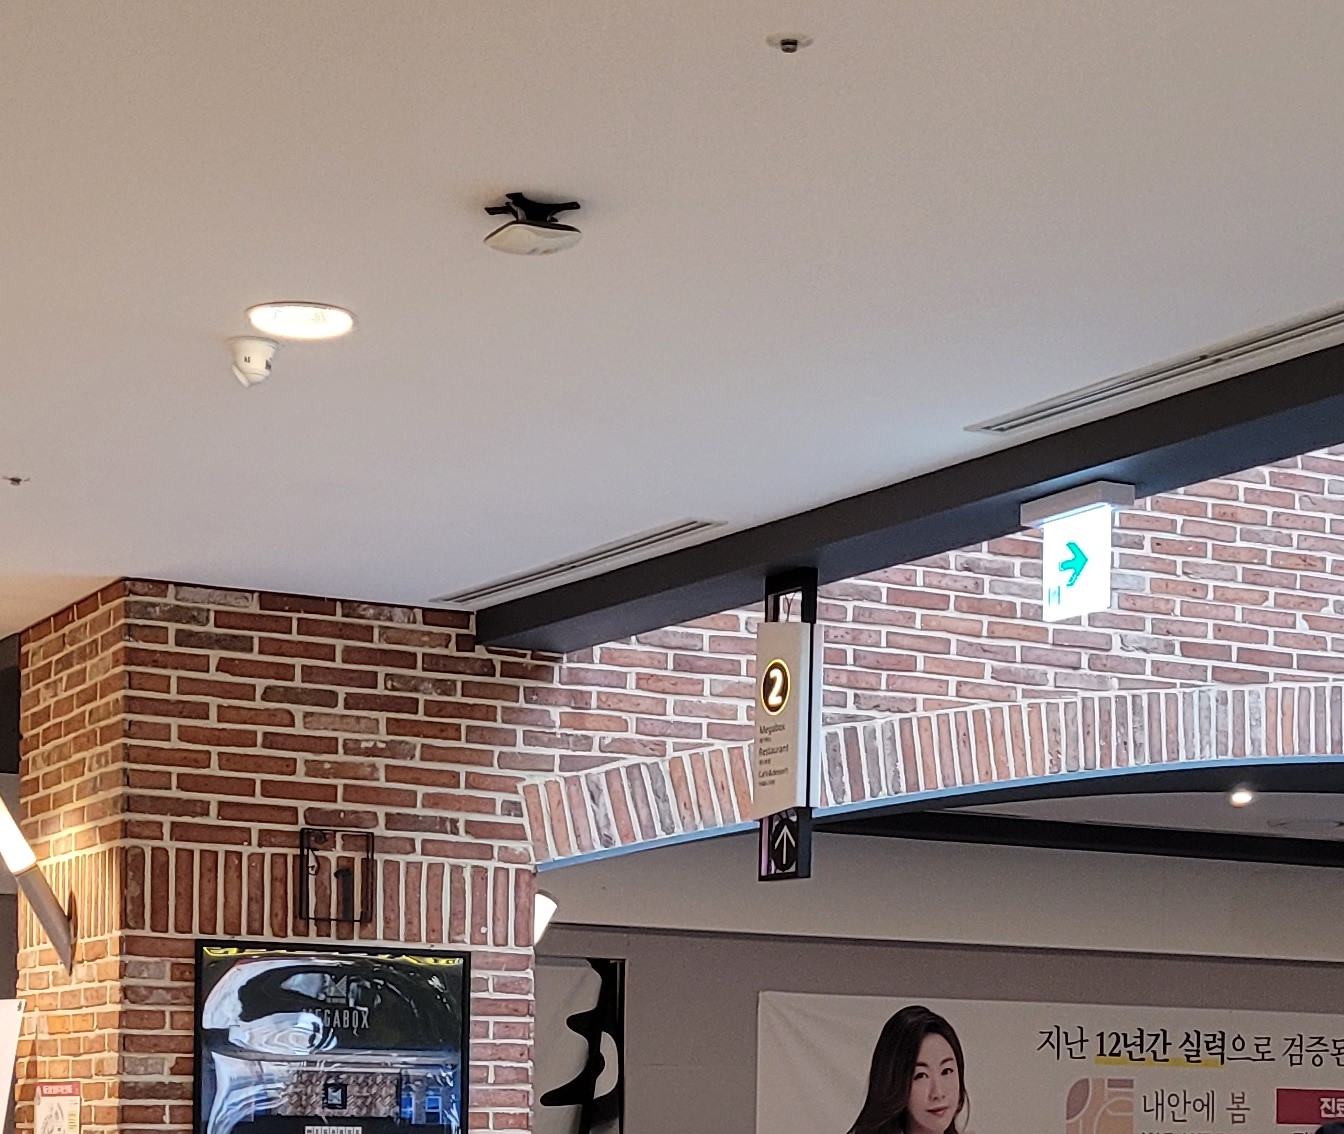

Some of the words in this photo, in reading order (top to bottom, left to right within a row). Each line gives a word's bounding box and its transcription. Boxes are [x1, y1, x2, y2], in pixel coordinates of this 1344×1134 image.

[767, 667, 783, 707] 2
[303, 1008, 369, 1029] GABOX
[1036, 1025, 1089, 1061] 지난
[1095, 1027, 1173, 1063] 12년간
[1178, 1029, 1276, 1065] 실력으로
[1141, 1089, 1216, 1123] 내안에
[1226, 1091, 1251, 1125] 봄
